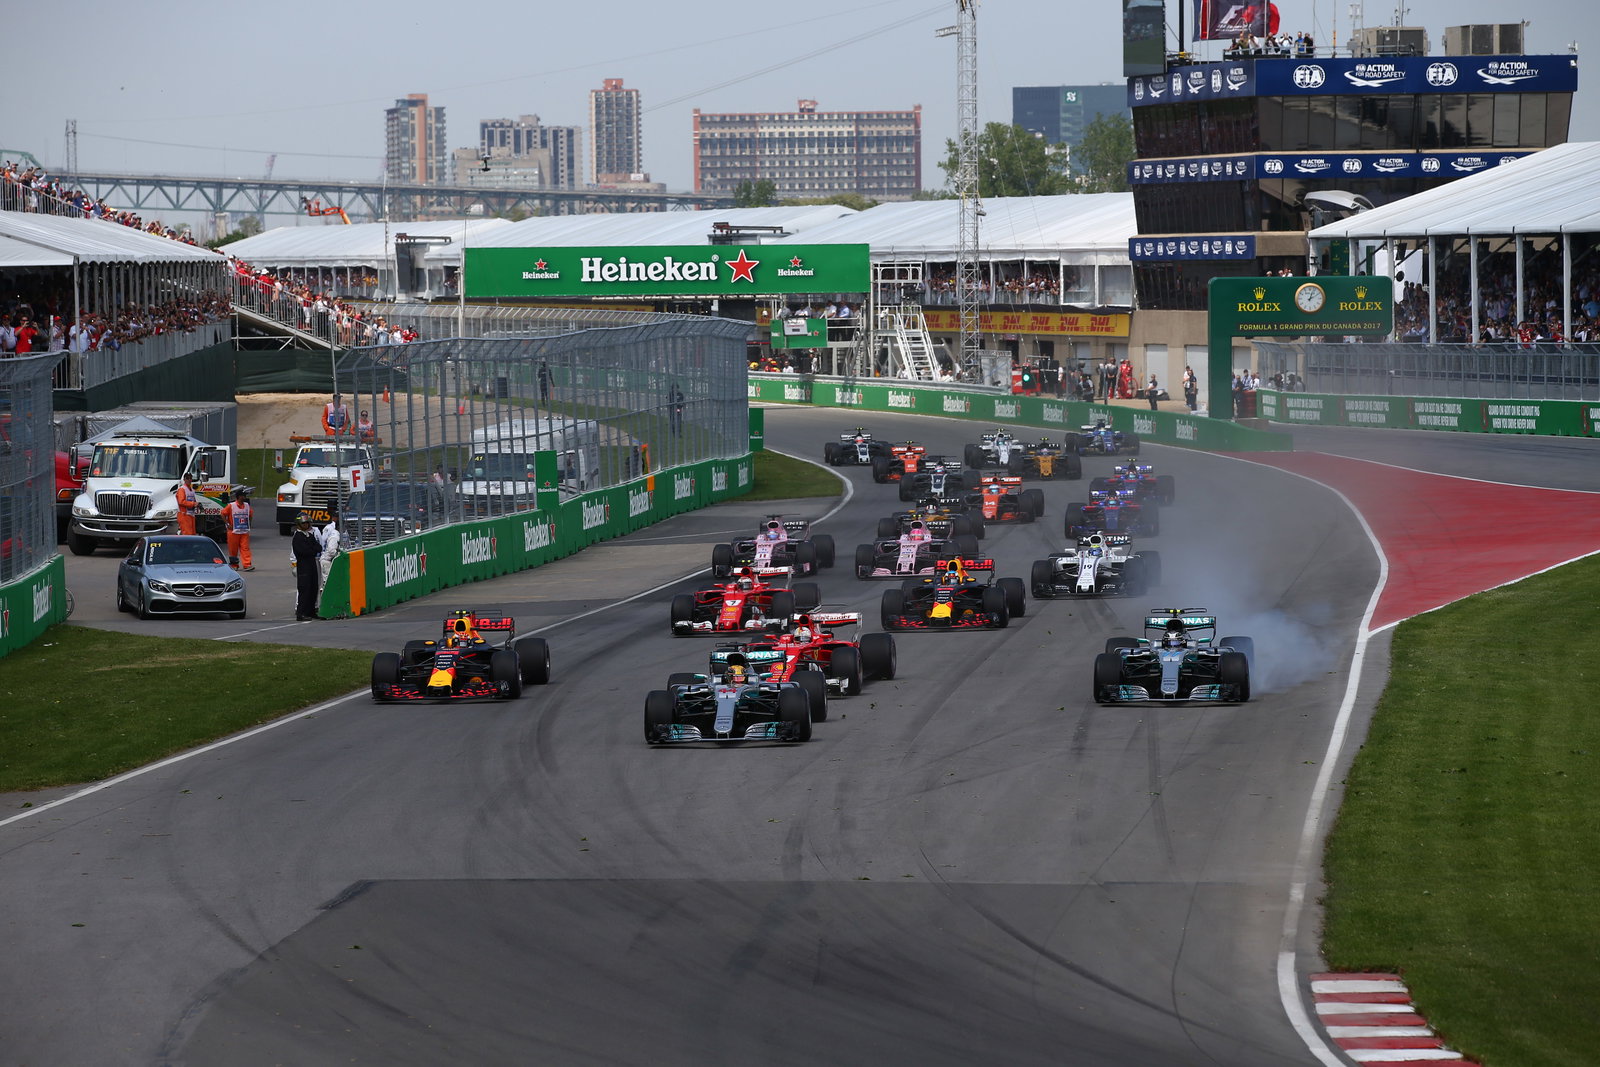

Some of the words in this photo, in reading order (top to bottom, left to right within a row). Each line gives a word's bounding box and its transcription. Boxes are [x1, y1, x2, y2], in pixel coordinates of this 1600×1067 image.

[1295, 68, 1323, 84] FIA
[1427, 66, 1455, 82] FIA
[1265, 162, 1282, 171] FIA
[1343, 160, 1360, 170] FIA
[1422, 160, 1439, 170] FIA
[522, 272, 559, 280] Heineken
[581, 256, 718, 282] Heineken
[777, 268, 814, 276] Heineken
[1238, 302, 1281, 312] ROLEX
[1340, 302, 1382, 310] ROLEX
[1089, 316, 1110, 332] DHL
[352, 470, 360, 488] F
[674, 473, 691, 500] Heineken
[629, 486, 649, 517] Heineken
[582, 499, 604, 530] Heineken
[524, 518, 550, 552] Heineken
[462, 530, 491, 565] Heineken
[384, 547, 418, 588] Heineken
